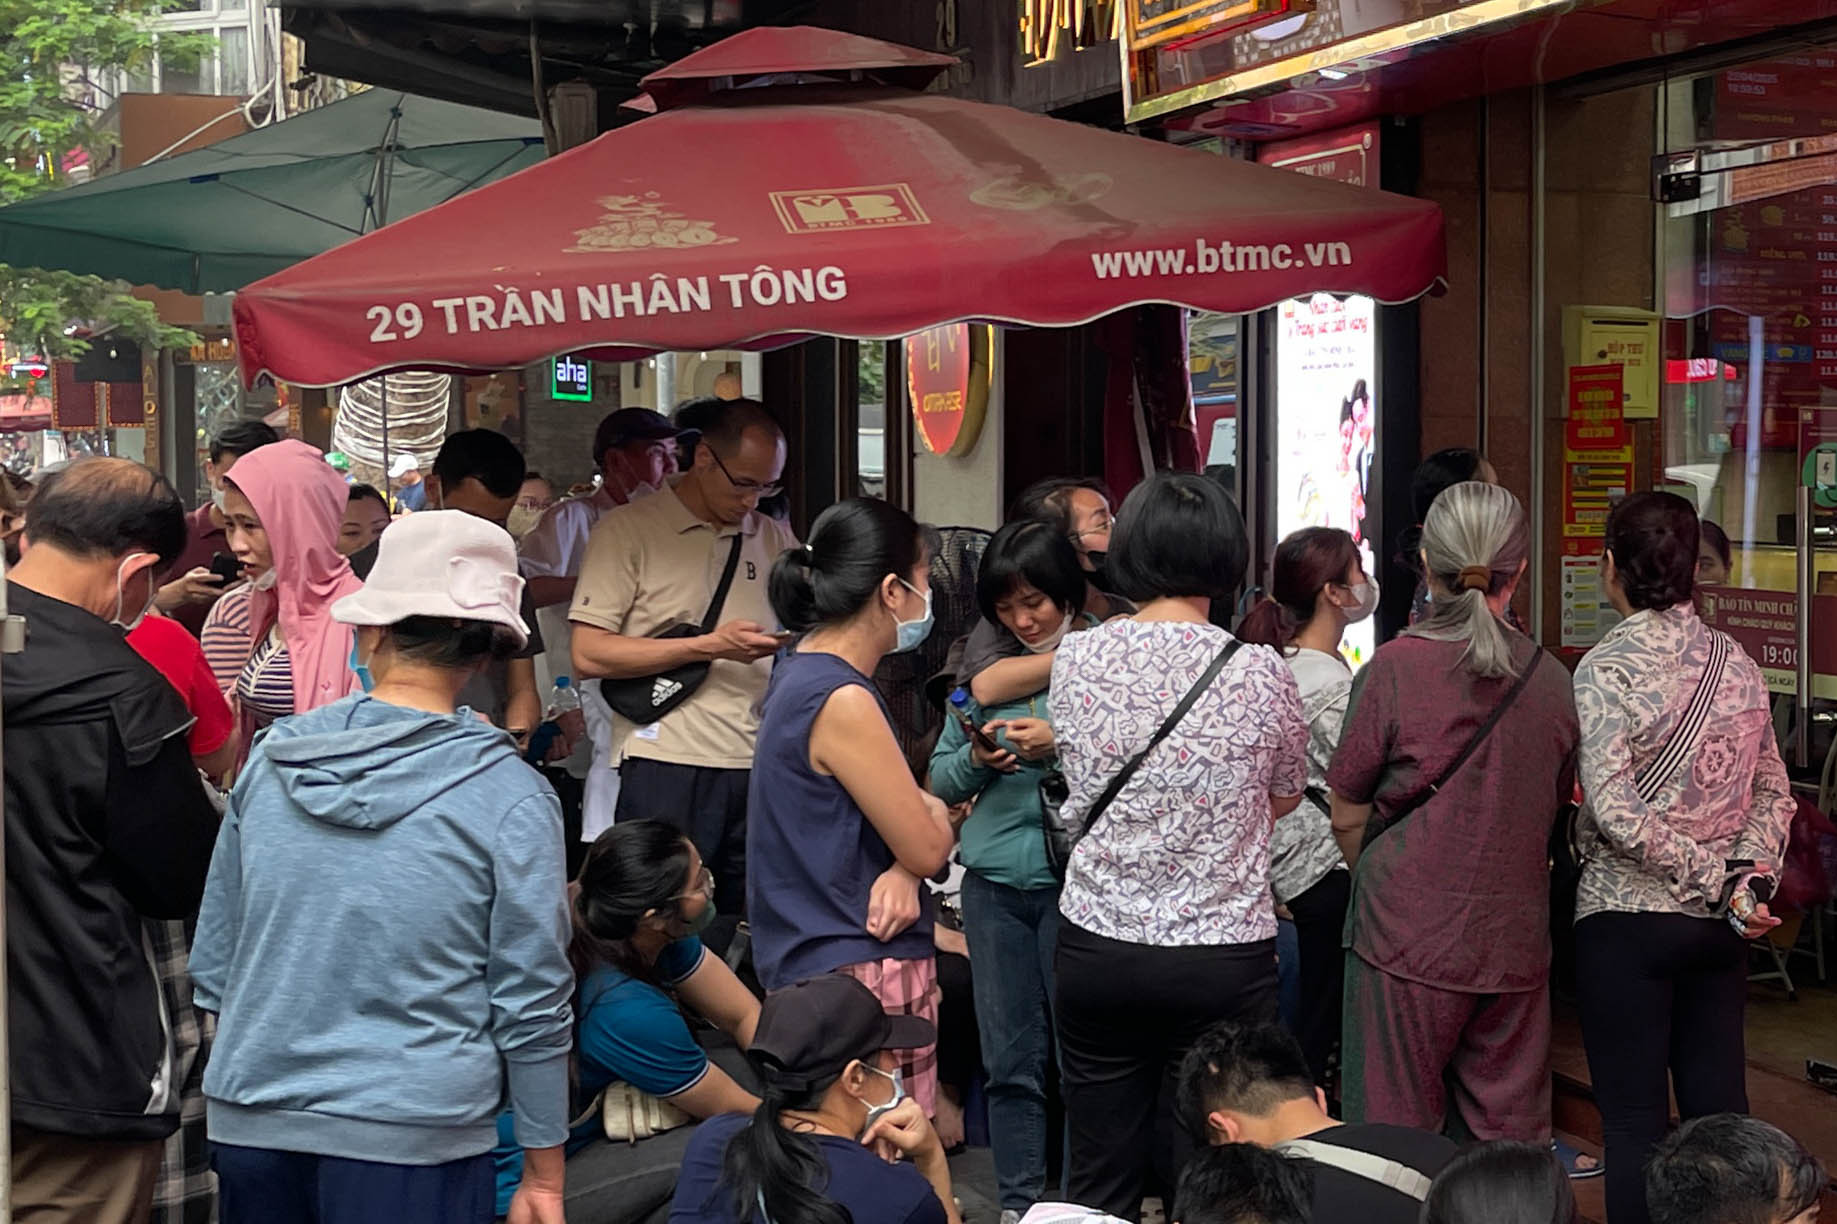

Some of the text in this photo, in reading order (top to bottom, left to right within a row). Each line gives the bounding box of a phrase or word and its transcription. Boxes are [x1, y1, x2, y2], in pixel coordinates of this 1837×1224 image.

[1092, 238, 1352, 279] www.btmc.vn
[366, 264, 848, 343] 29 TRẦN NHÂN TÔNG
[556, 355, 587, 382] aha
[652, 681, 683, 707] adidas
